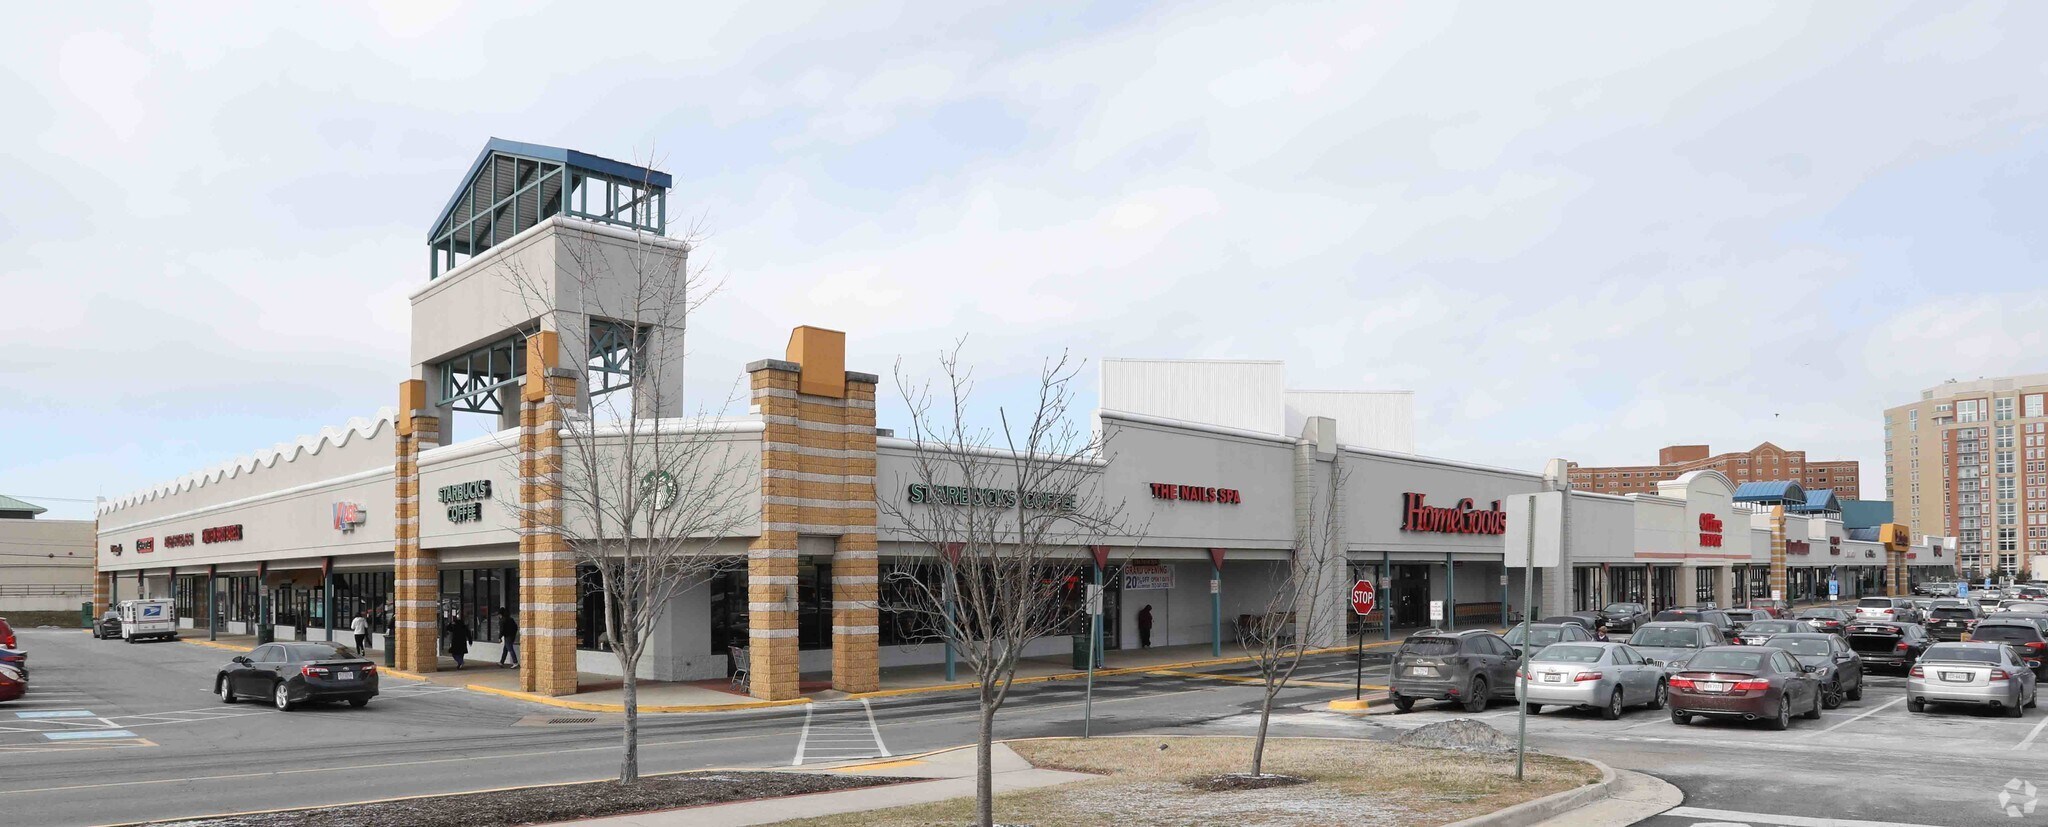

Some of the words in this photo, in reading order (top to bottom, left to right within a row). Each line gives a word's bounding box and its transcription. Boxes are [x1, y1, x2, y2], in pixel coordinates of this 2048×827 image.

[438, 480, 491, 503] STARBUCKS
[908, 483, 1016, 508] STARBUCKS
[1023, 489, 1077, 512] COFFEE
[1150, 483, 1178, 500] THE
[1179, 485, 1217, 503] NAILS
[1217, 488, 1241, 504] SPA
[447, 502, 482, 523] COFFEE
[1400, 492, 1506, 535] HomeGoods
[1125, 565, 1144, 575] GRAND
[1144, 565, 1168, 575] OPENING
[1353, 590, 1373, 605] STOP
